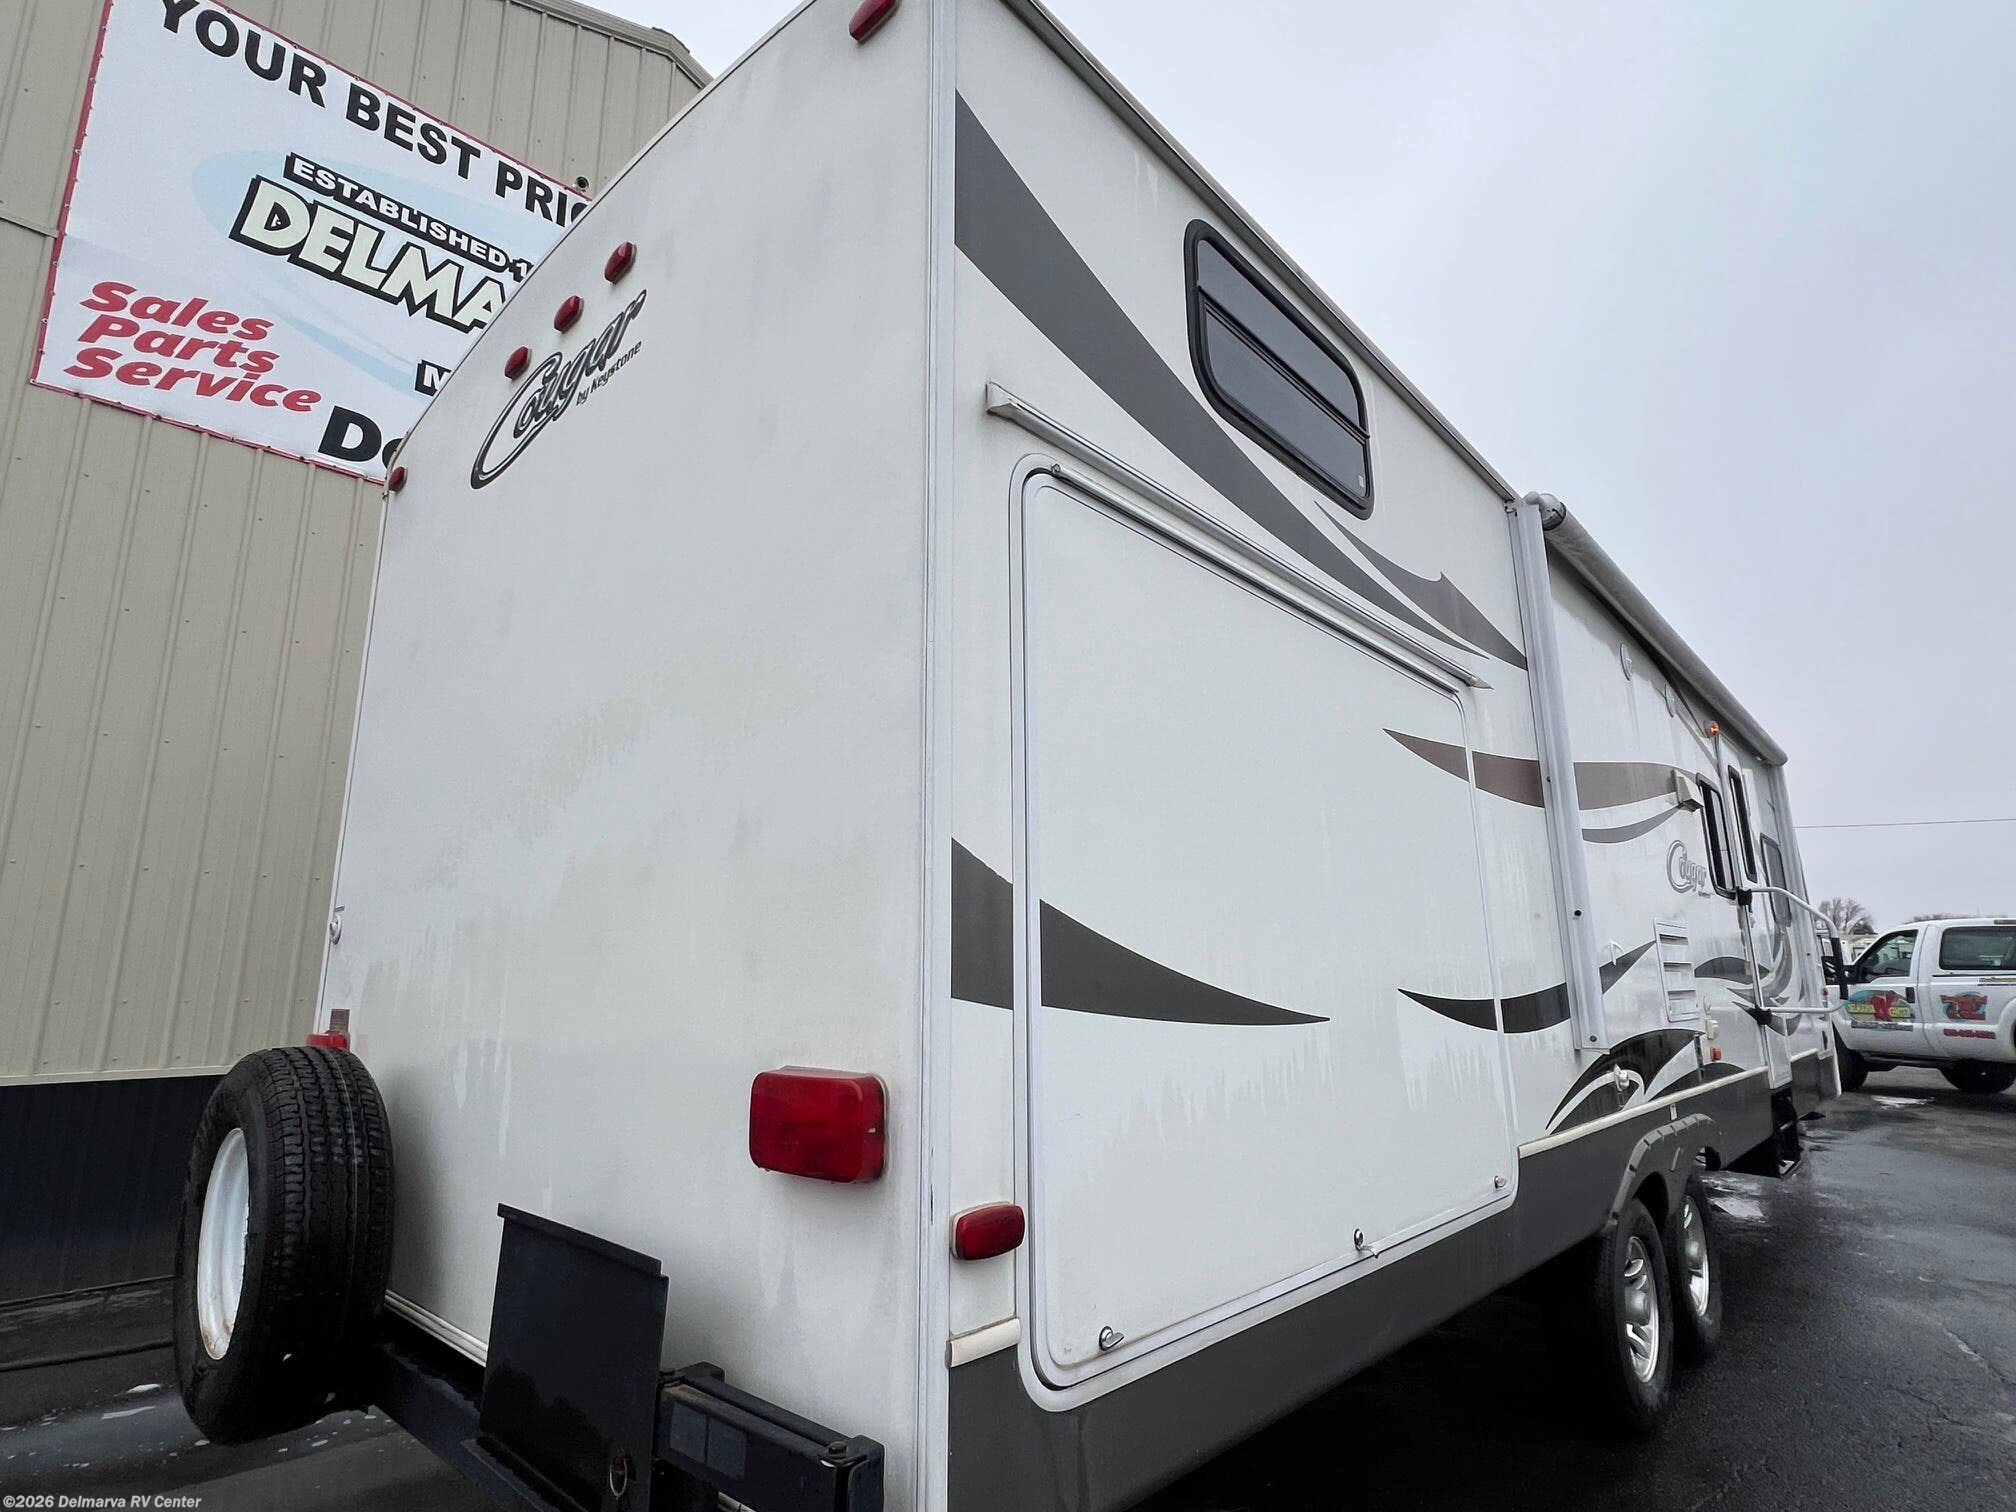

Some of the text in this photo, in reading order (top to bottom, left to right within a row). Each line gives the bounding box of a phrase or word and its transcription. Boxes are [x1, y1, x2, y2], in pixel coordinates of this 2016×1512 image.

[161, 0, 327, 109] YOUR
[345, 82, 482, 180] BEST
[290, 155, 508, 268] ESTABLISHED
[77, 314, 280, 373] Parts
[79, 281, 275, 341] Sales
[63, 347, 322, 412] Service
[470, 289, 647, 490] Cougar
[576, 341, 642, 406] by Keystone
